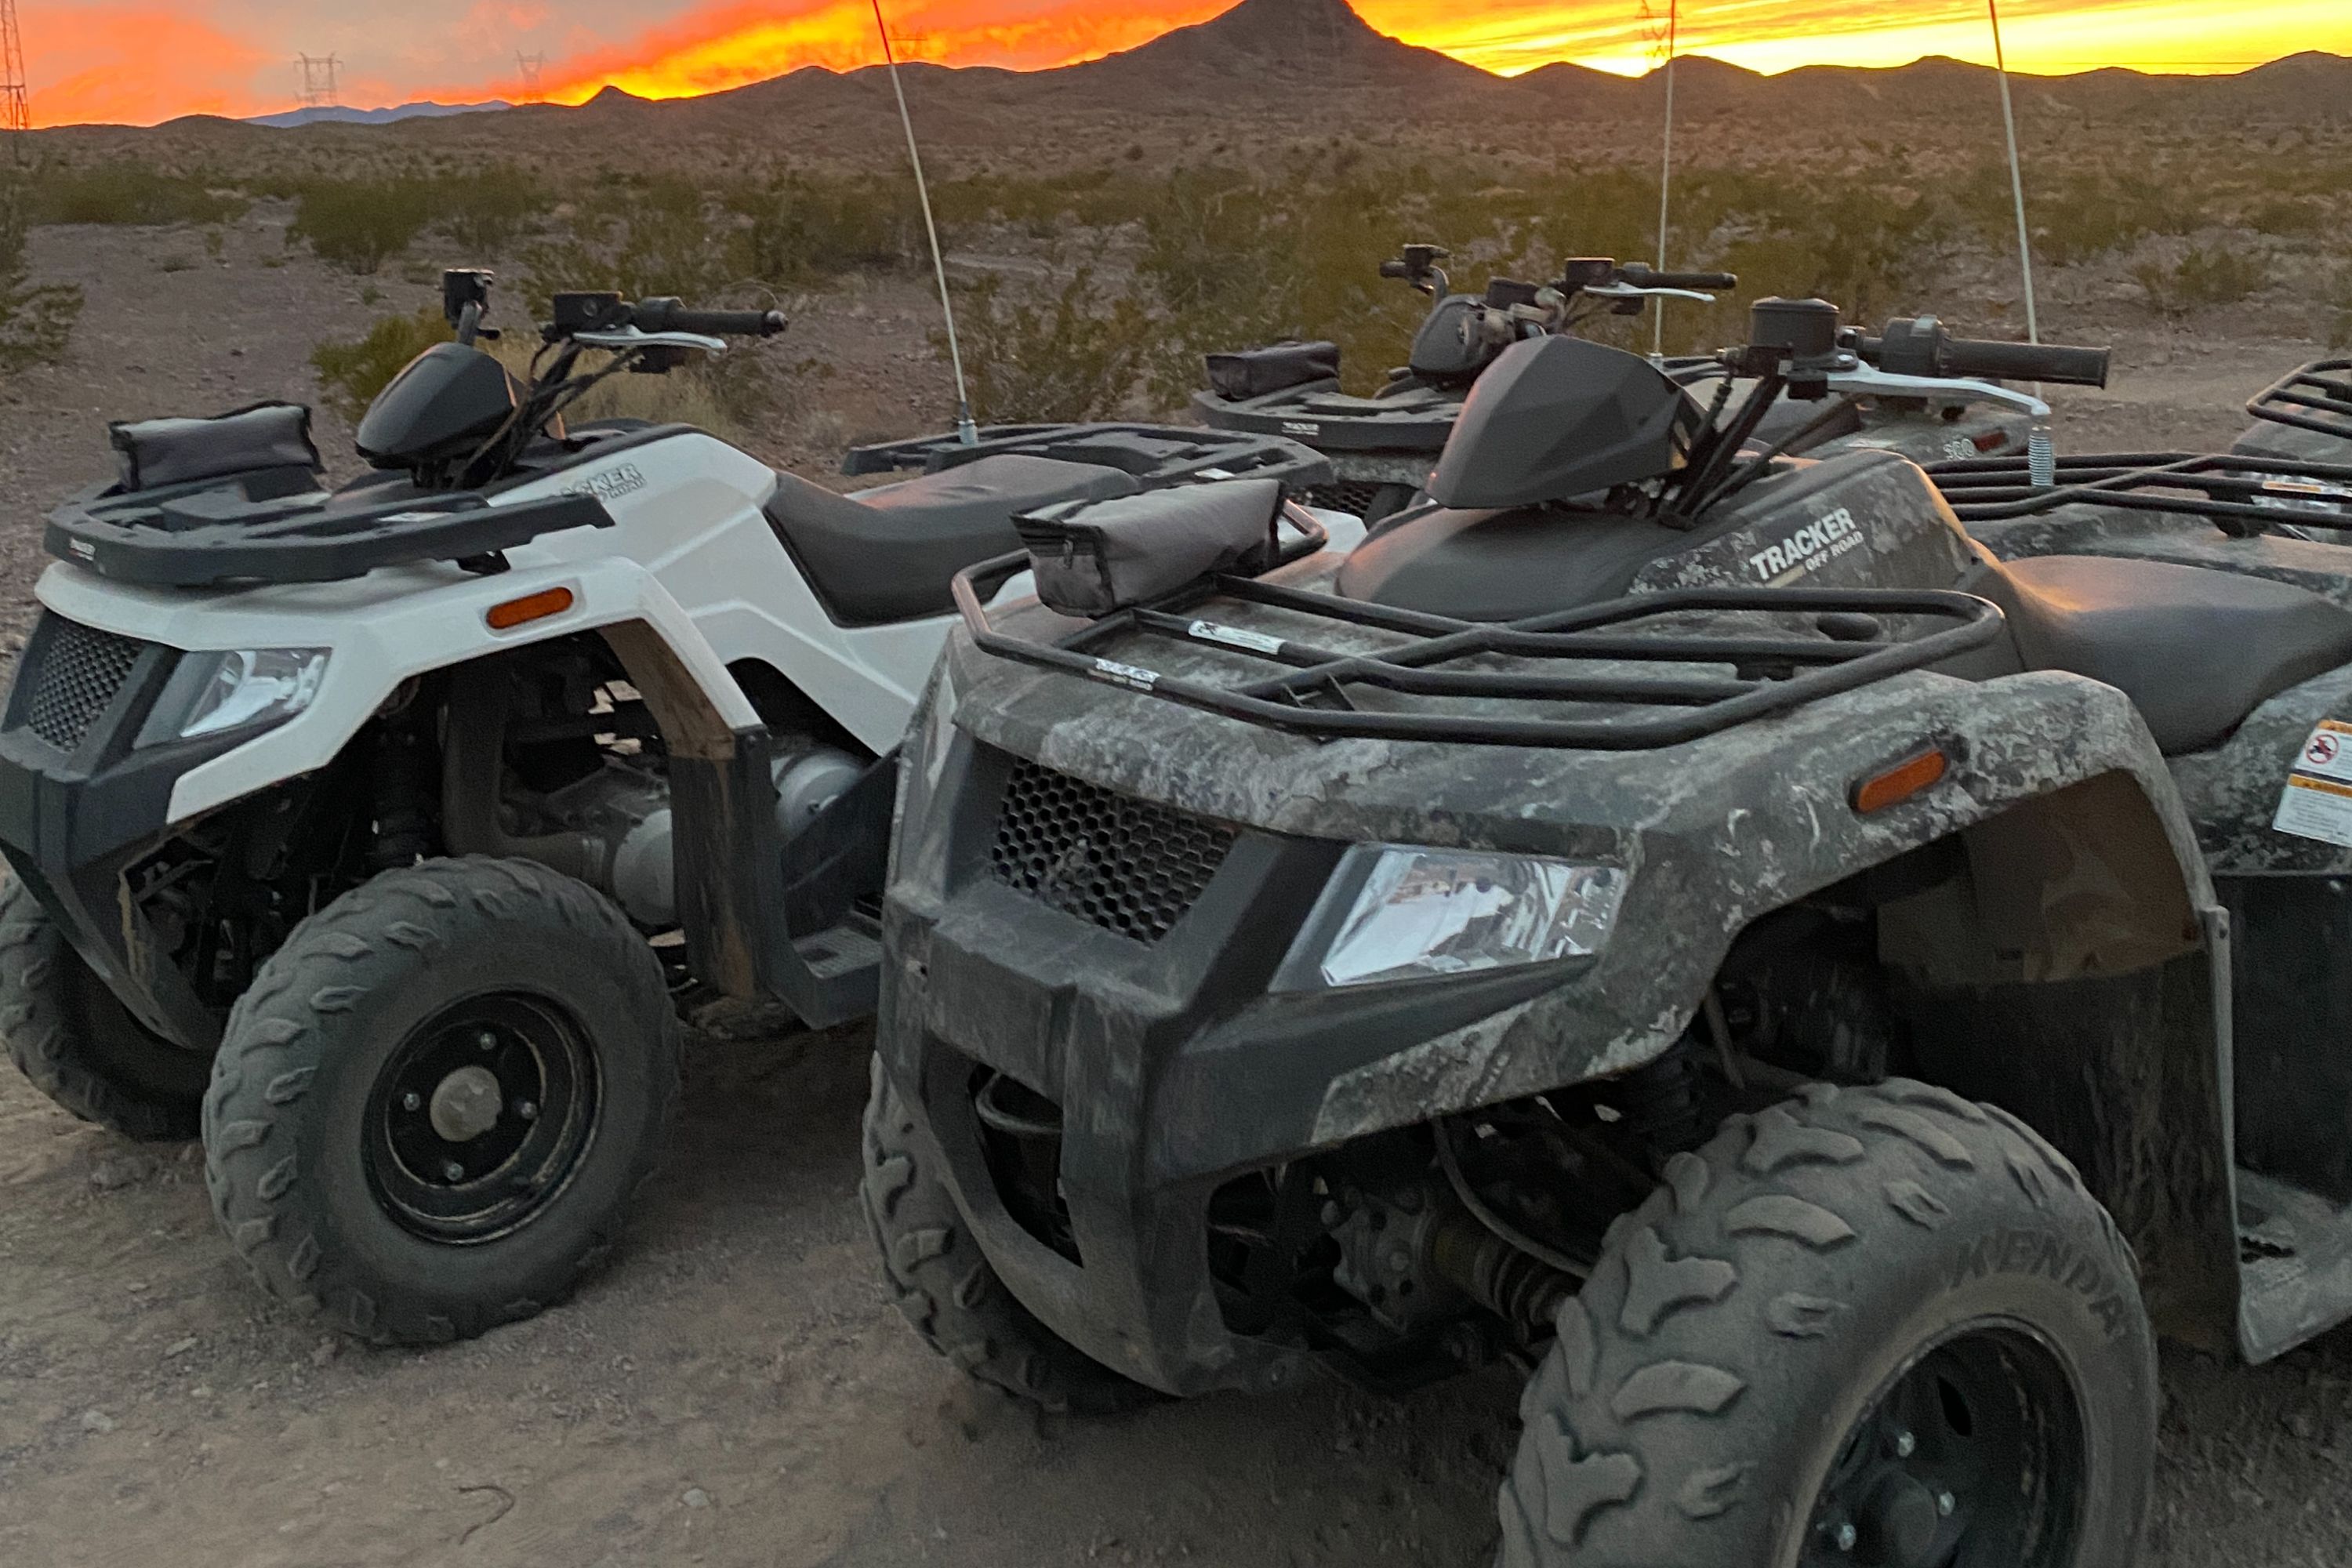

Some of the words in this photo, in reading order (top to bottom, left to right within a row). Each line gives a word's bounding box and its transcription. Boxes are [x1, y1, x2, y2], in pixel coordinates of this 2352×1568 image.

[1749, 507, 1857, 580] TRACKER
[1804, 550, 1830, 572] OFF
[1831, 531, 1864, 558] ROAD
[1949, 1229, 2126, 1338] KENDA
